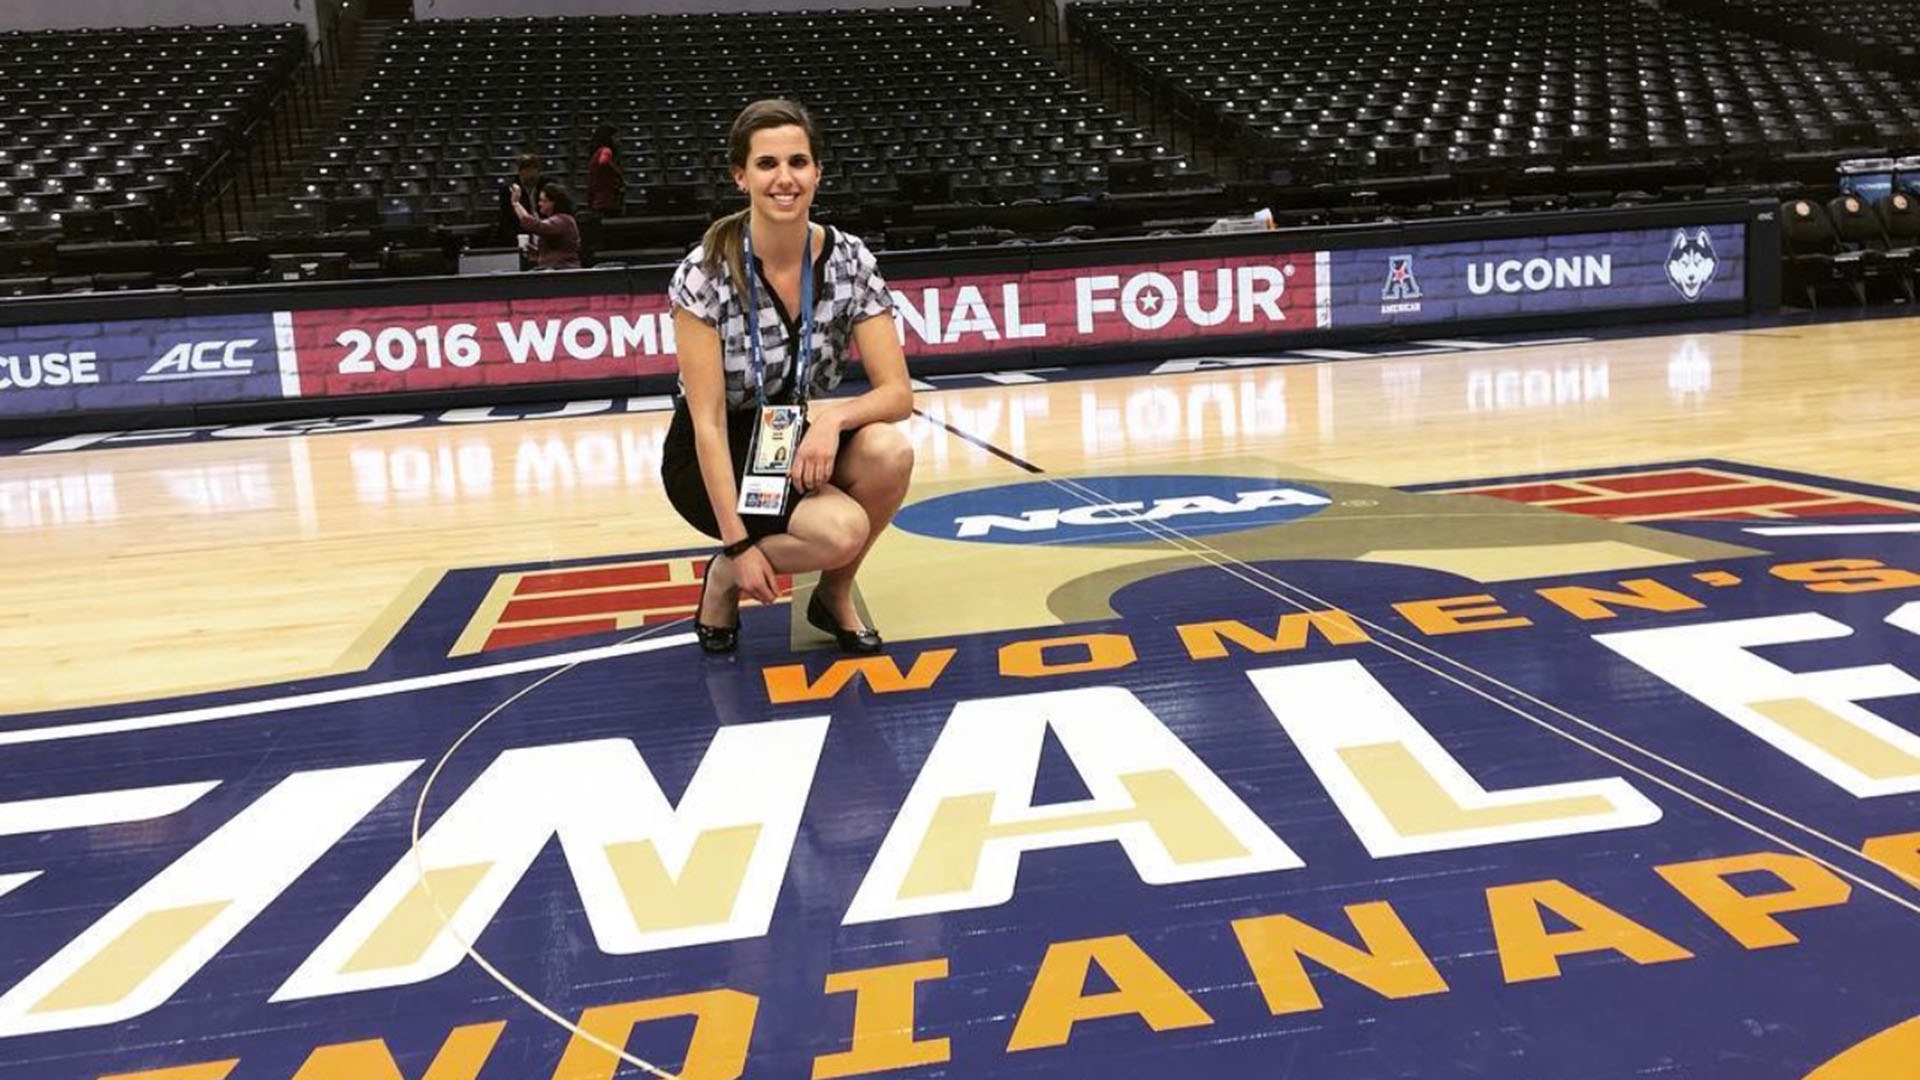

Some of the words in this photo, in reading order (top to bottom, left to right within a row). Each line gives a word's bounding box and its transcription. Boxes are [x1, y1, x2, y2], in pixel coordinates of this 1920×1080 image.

[1467, 254, 1611, 295] UCONN
[336, 323, 482, 374] 2016
[1075, 264, 1285, 334] FOUR
[145, 339, 259, 374] ACC
[954, 488, 1333, 538] NCAA
[762, 558, 1920, 704] WOMEN'S
